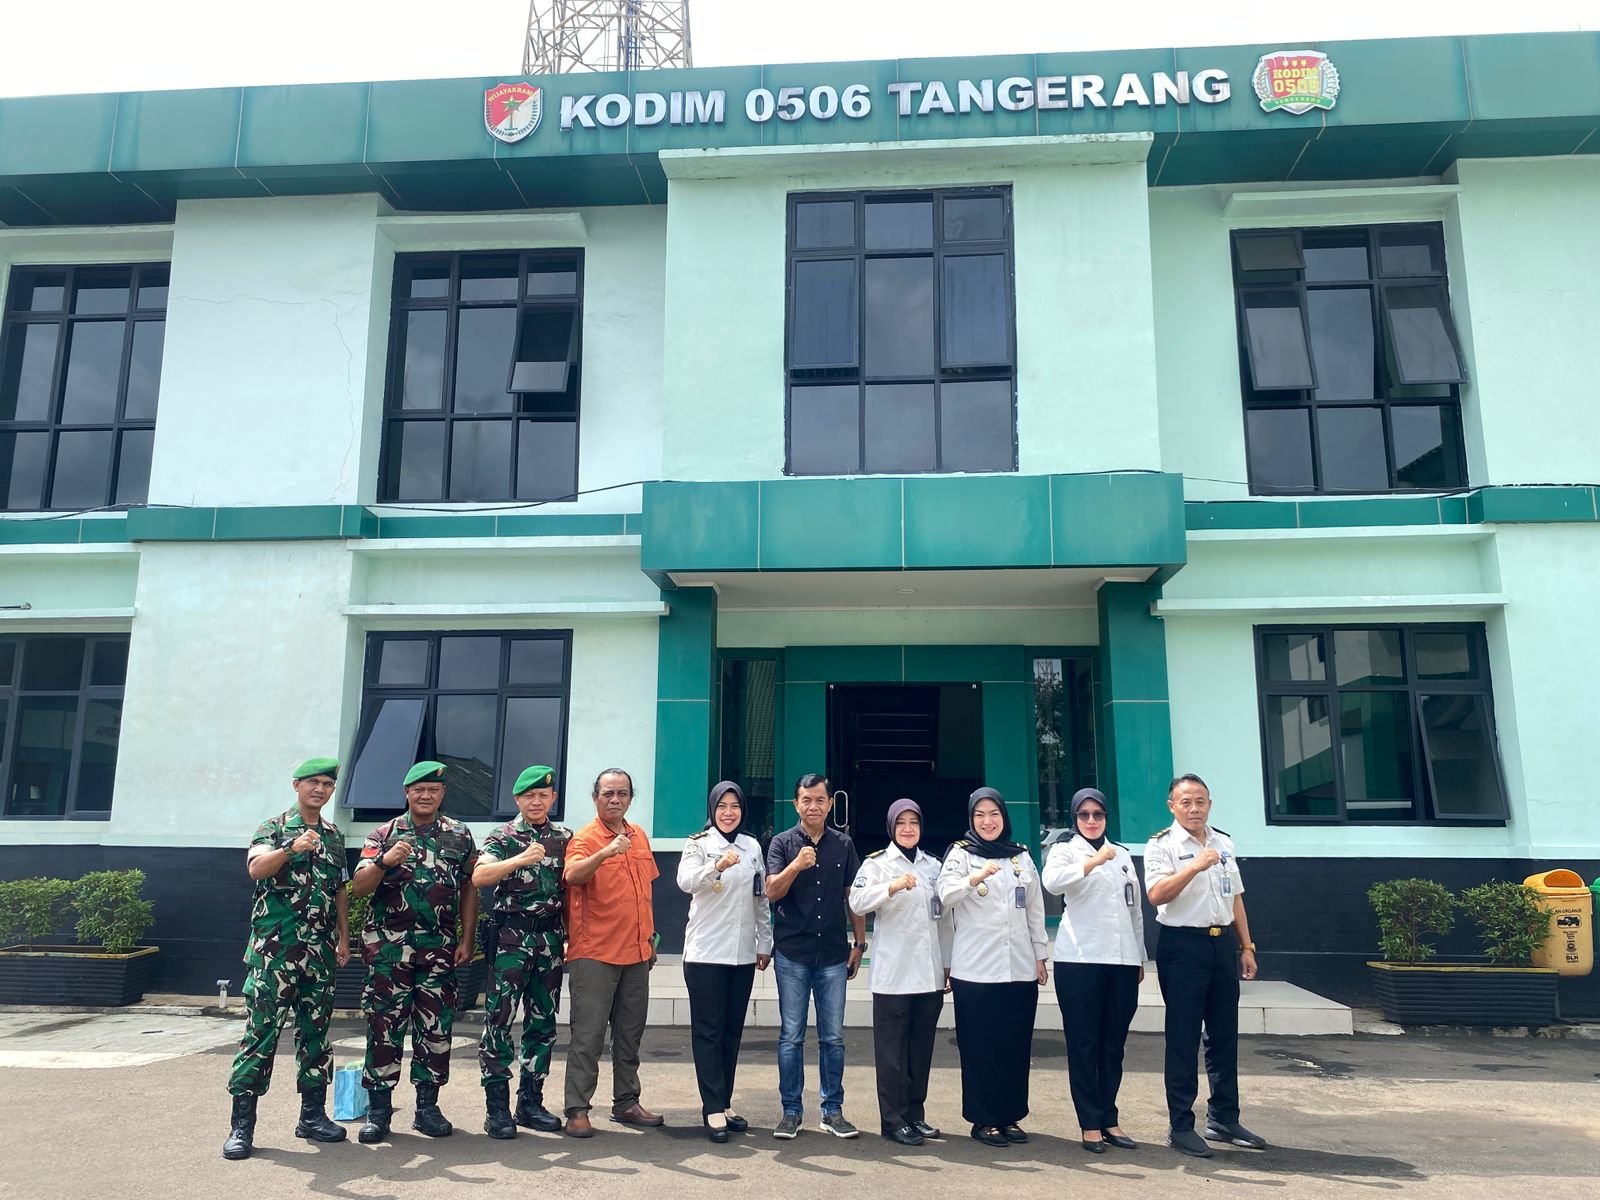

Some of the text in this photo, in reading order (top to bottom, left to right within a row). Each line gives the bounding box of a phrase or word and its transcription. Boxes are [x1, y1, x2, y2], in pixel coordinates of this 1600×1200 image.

[1273, 68, 1318, 79] KODIM
[559, 68, 1232, 132] KODIM 0506 TANGERANG
